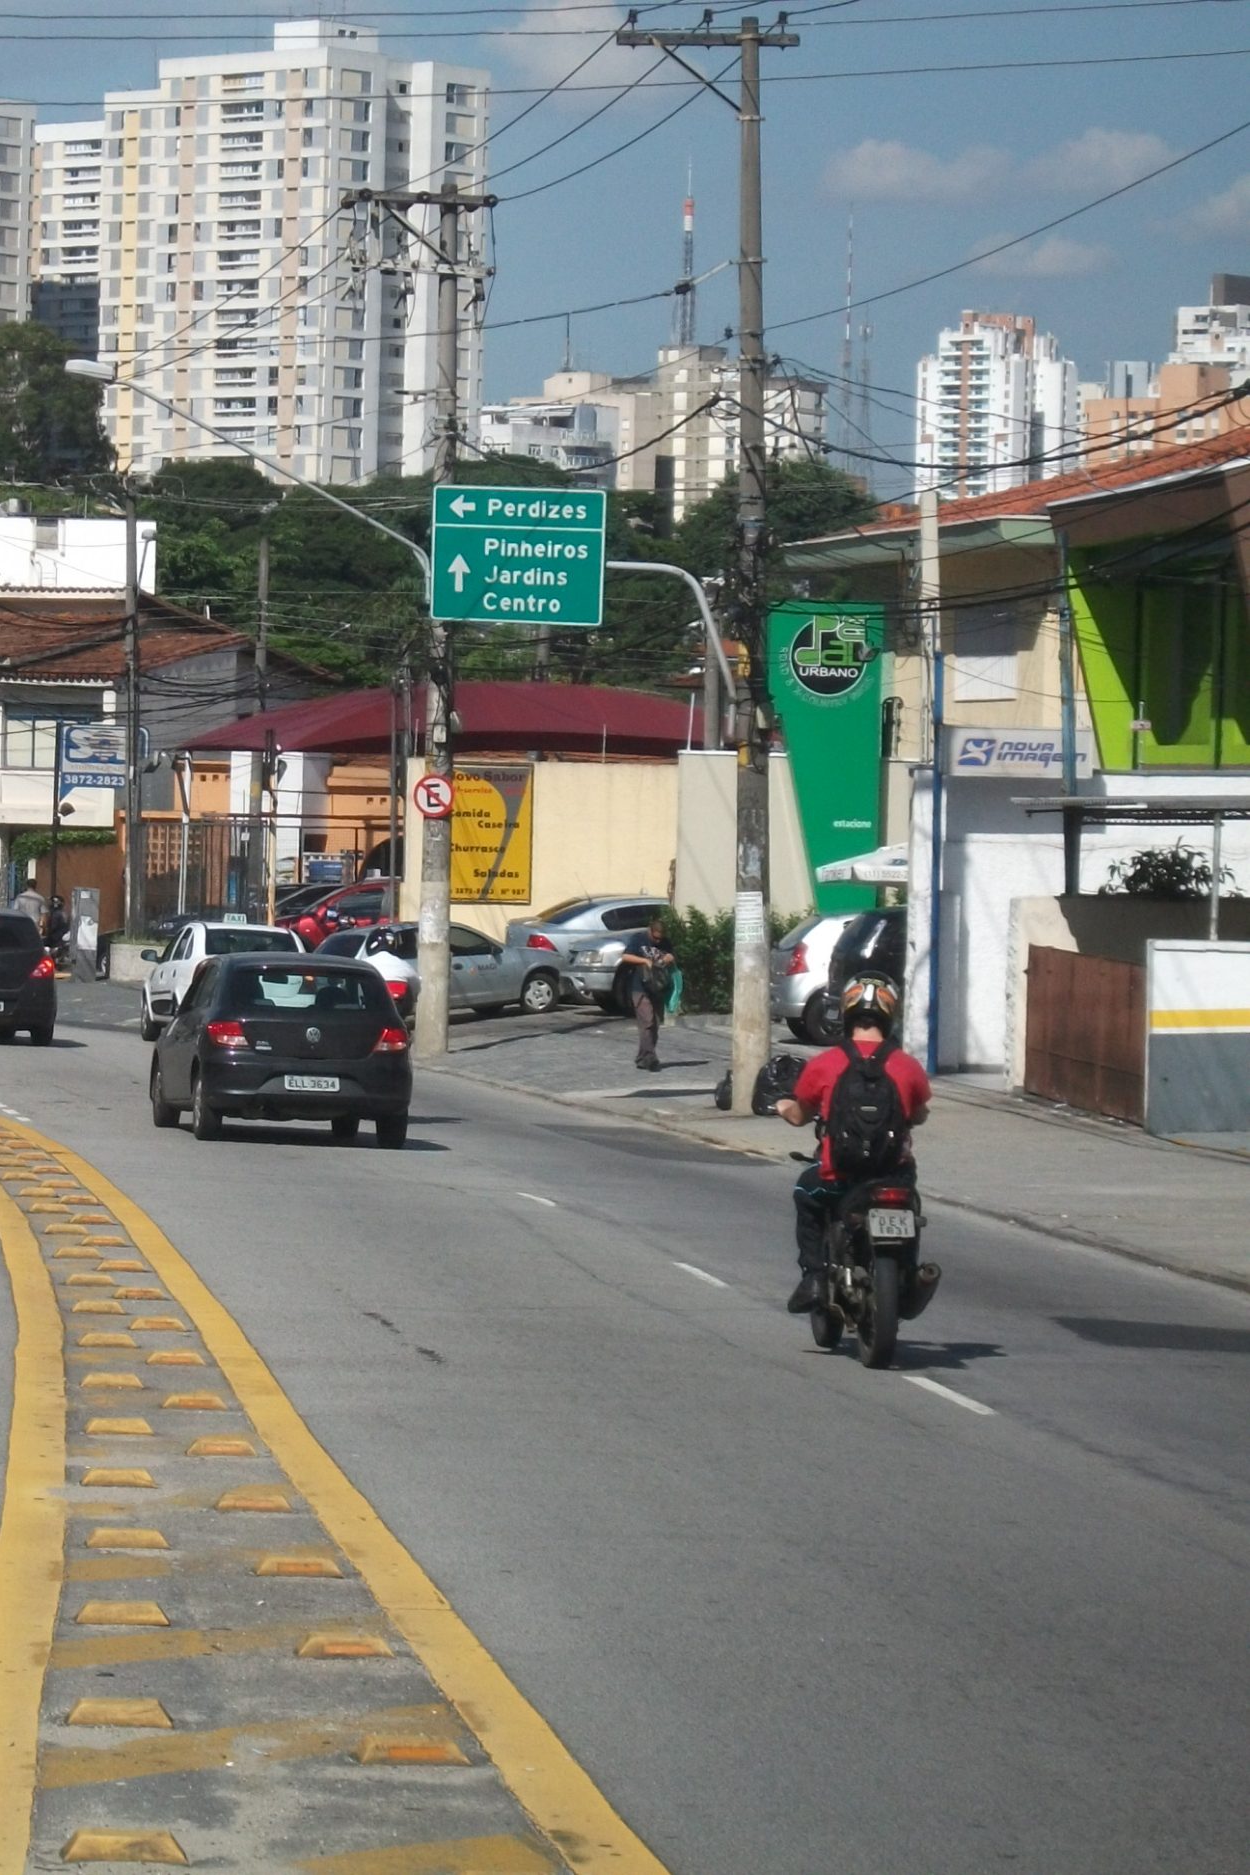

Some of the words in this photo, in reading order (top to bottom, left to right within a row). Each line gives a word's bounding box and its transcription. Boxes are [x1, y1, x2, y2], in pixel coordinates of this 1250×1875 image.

[487, 498, 587, 519] Perdizes
[484, 538, 589, 559] Pinheiros
[484, 565, 568, 585] Jardins
[483, 592, 561, 613] Centro
[799, 666, 859, 678] URBANO
[64, 775, 126, 787] 3872-2823
[477, 820, 521, 829] Caseira
[473, 868, 520, 879] Saladas
[226, 914, 246, 922] TAXI
